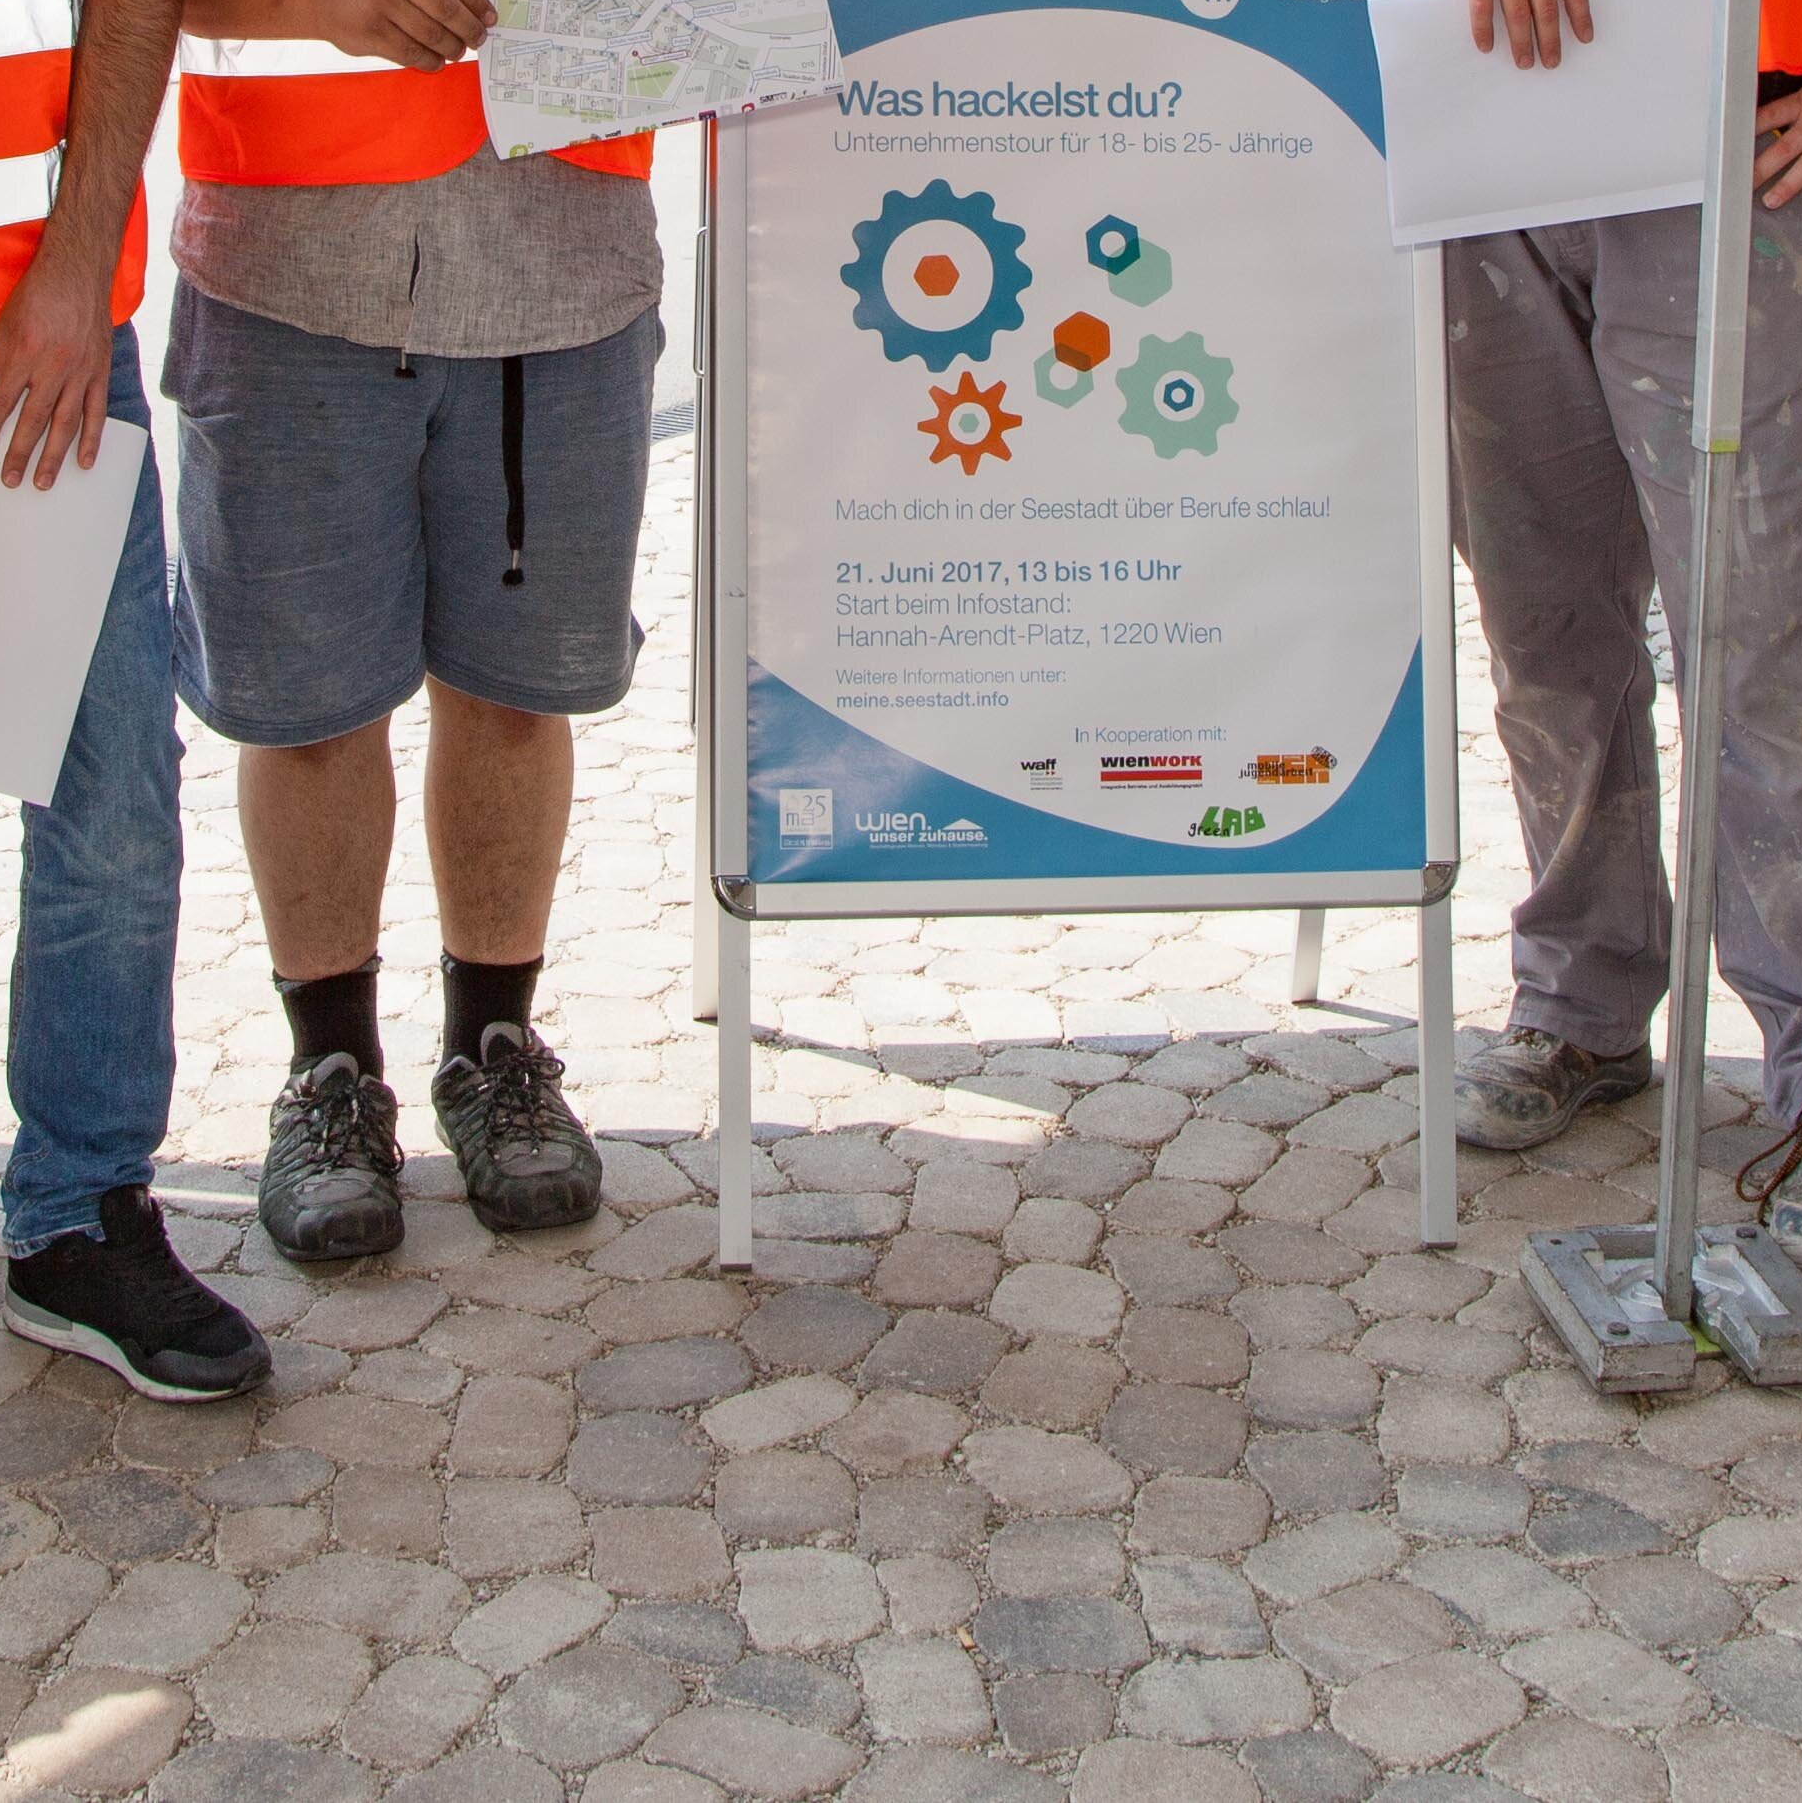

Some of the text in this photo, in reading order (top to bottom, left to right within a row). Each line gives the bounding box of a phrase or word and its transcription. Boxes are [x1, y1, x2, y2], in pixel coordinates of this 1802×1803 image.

[837, 79, 1183, 118] Was hackelst du?
[834, 130, 1313, 159] Unternehmenstour für 18- bis 25- Jährige
[836, 495, 1332, 521] Mach dich in der Seestadt über Berufe schlau!
[836, 559, 1182, 587] 21. Juni 2017, 13 bis 16 Uhr
[836, 593, 1072, 615] Start beim Infostand:
[836, 621, 1223, 649] Hannah-Arendt-Platz, 1220 Wien
[836, 667, 1067, 685] Weitere Informationen unter:
[836, 691, 1009, 709] meine.seestadt.info
[1075, 726, 1227, 746] In Kooperation mit:
[1020, 758, 1057, 771] waff
[1100, 755, 1202, 768] wienwork
[1247, 762, 1286, 770] mobile
[1238, 767, 1314, 779] jugendarbeit
[802, 794, 827, 819] 25
[855, 812, 933, 832] wien.
[1187, 822, 1231, 838] green
[1198, 805, 1266, 838] LAB
[869, 829, 989, 844] unser zuhause.
